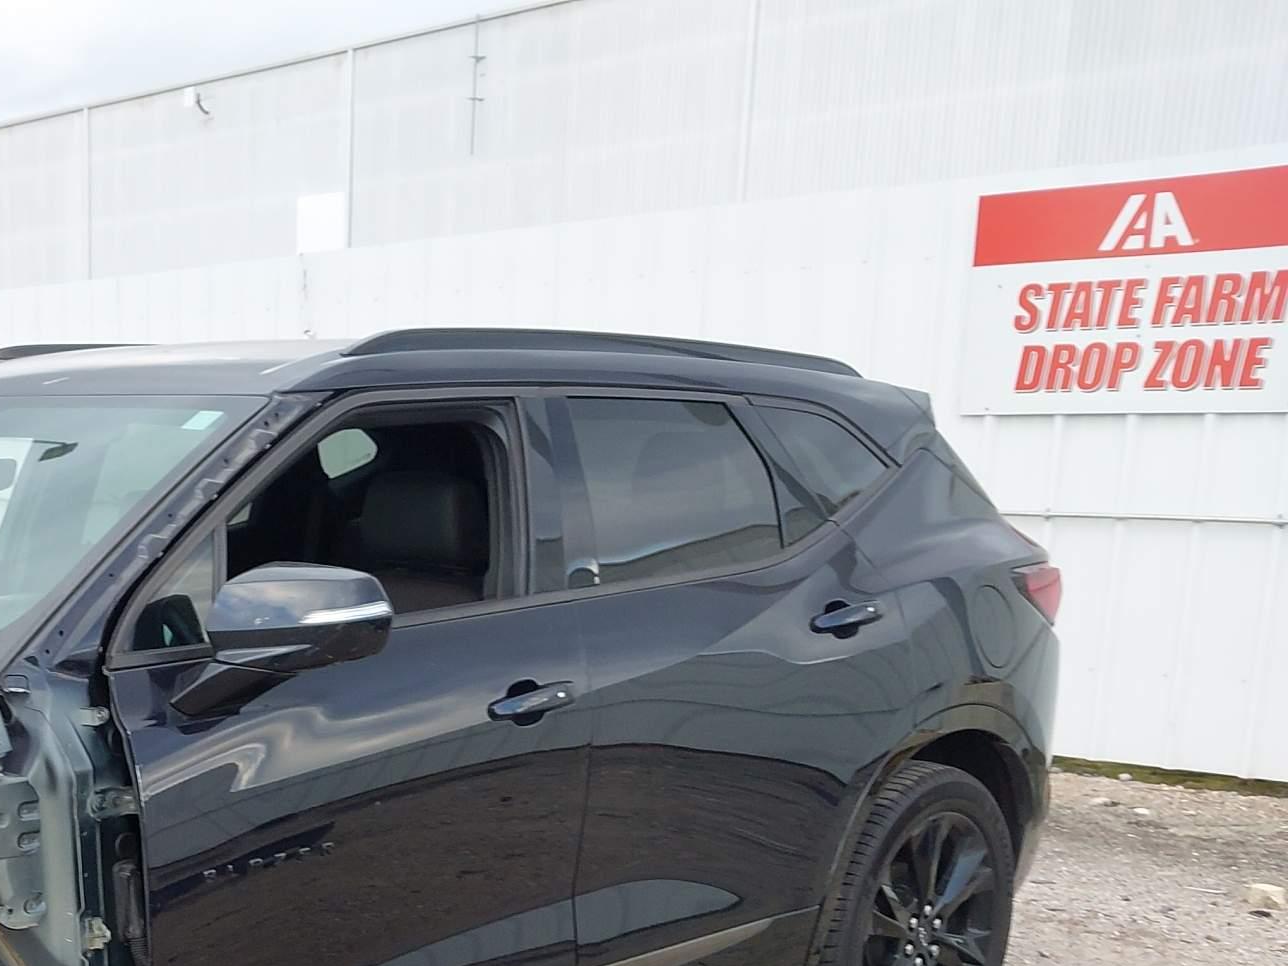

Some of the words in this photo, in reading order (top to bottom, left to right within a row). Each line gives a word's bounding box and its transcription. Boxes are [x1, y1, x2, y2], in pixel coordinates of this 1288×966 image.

[1014, 277, 1148, 334] STATE
[1150, 268, 1288, 328] FARM
[1015, 341, 1142, 393] DROP
[1144, 336, 1273, 392] ZONE
